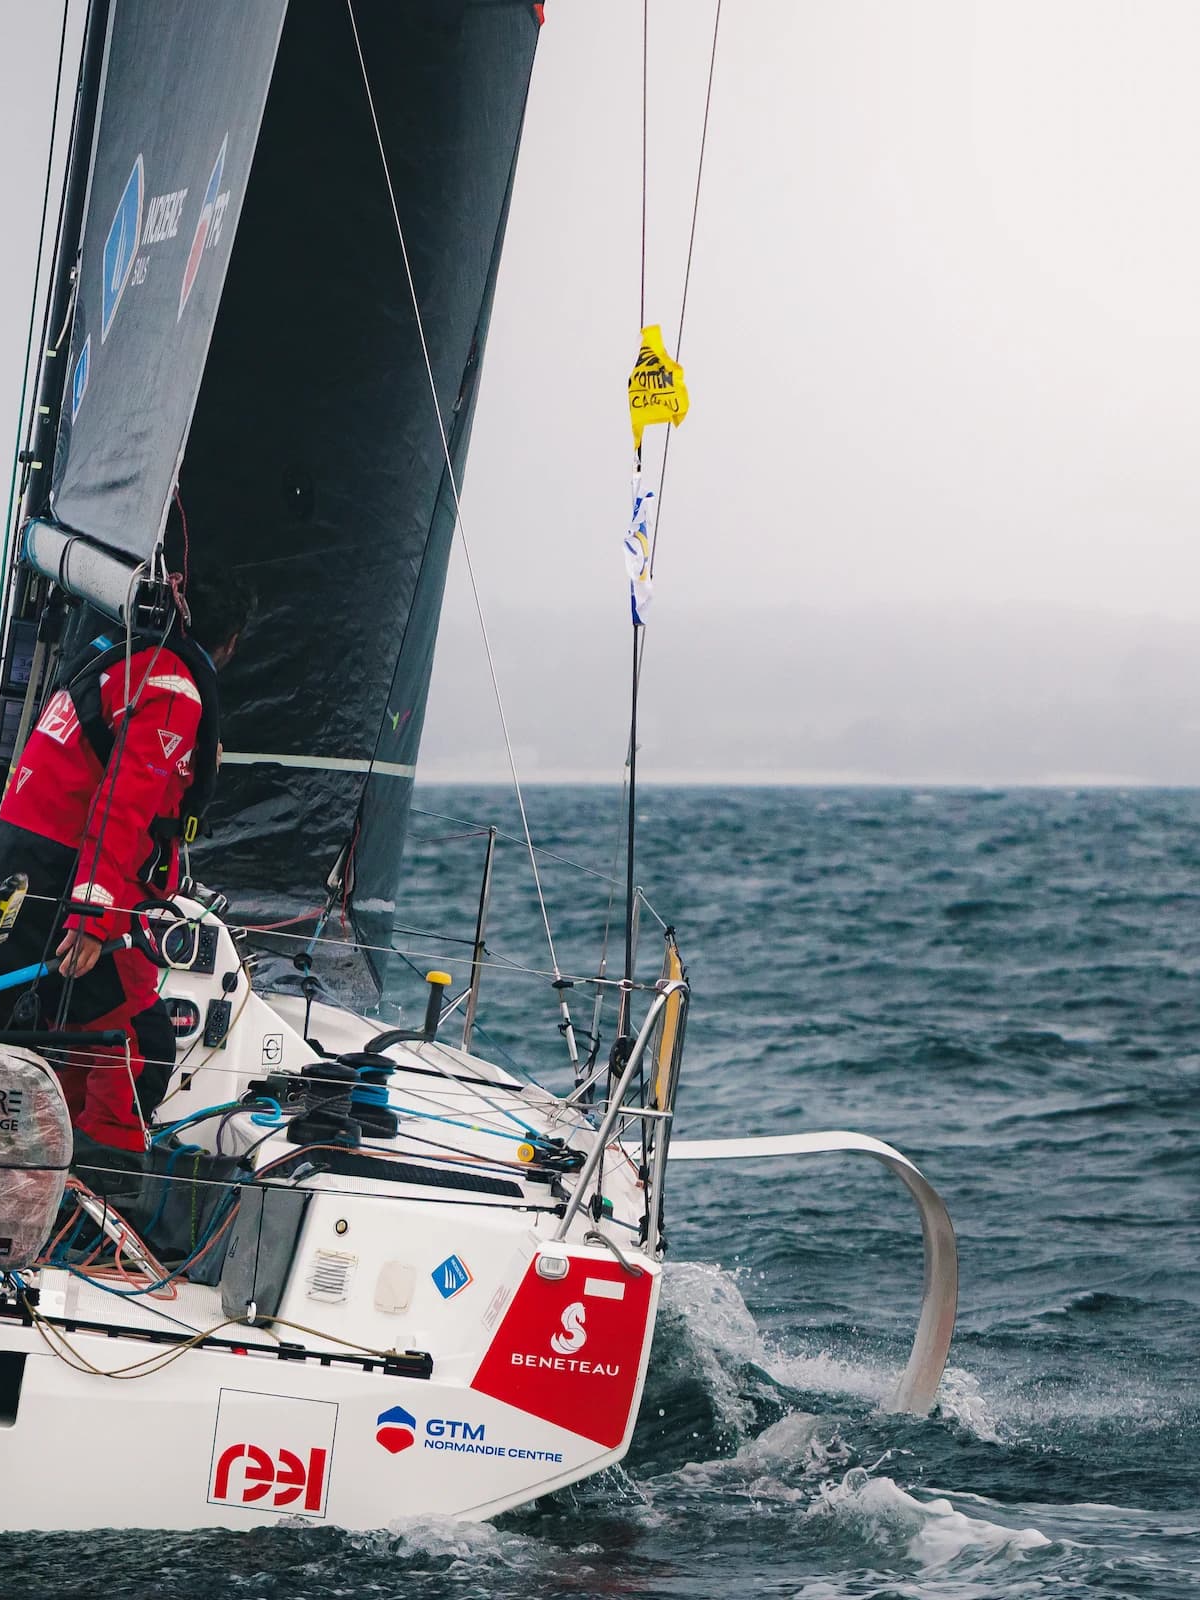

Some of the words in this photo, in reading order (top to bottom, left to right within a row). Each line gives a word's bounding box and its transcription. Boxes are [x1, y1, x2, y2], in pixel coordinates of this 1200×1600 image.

[511, 1353, 620, 1377] BENETEAU
[425, 1418, 485, 1441] GTM
[424, 1439, 506, 1457] NORMANDIE
[508, 1448, 563, 1463] CENTRE
[214, 1443, 327, 1511] reel
